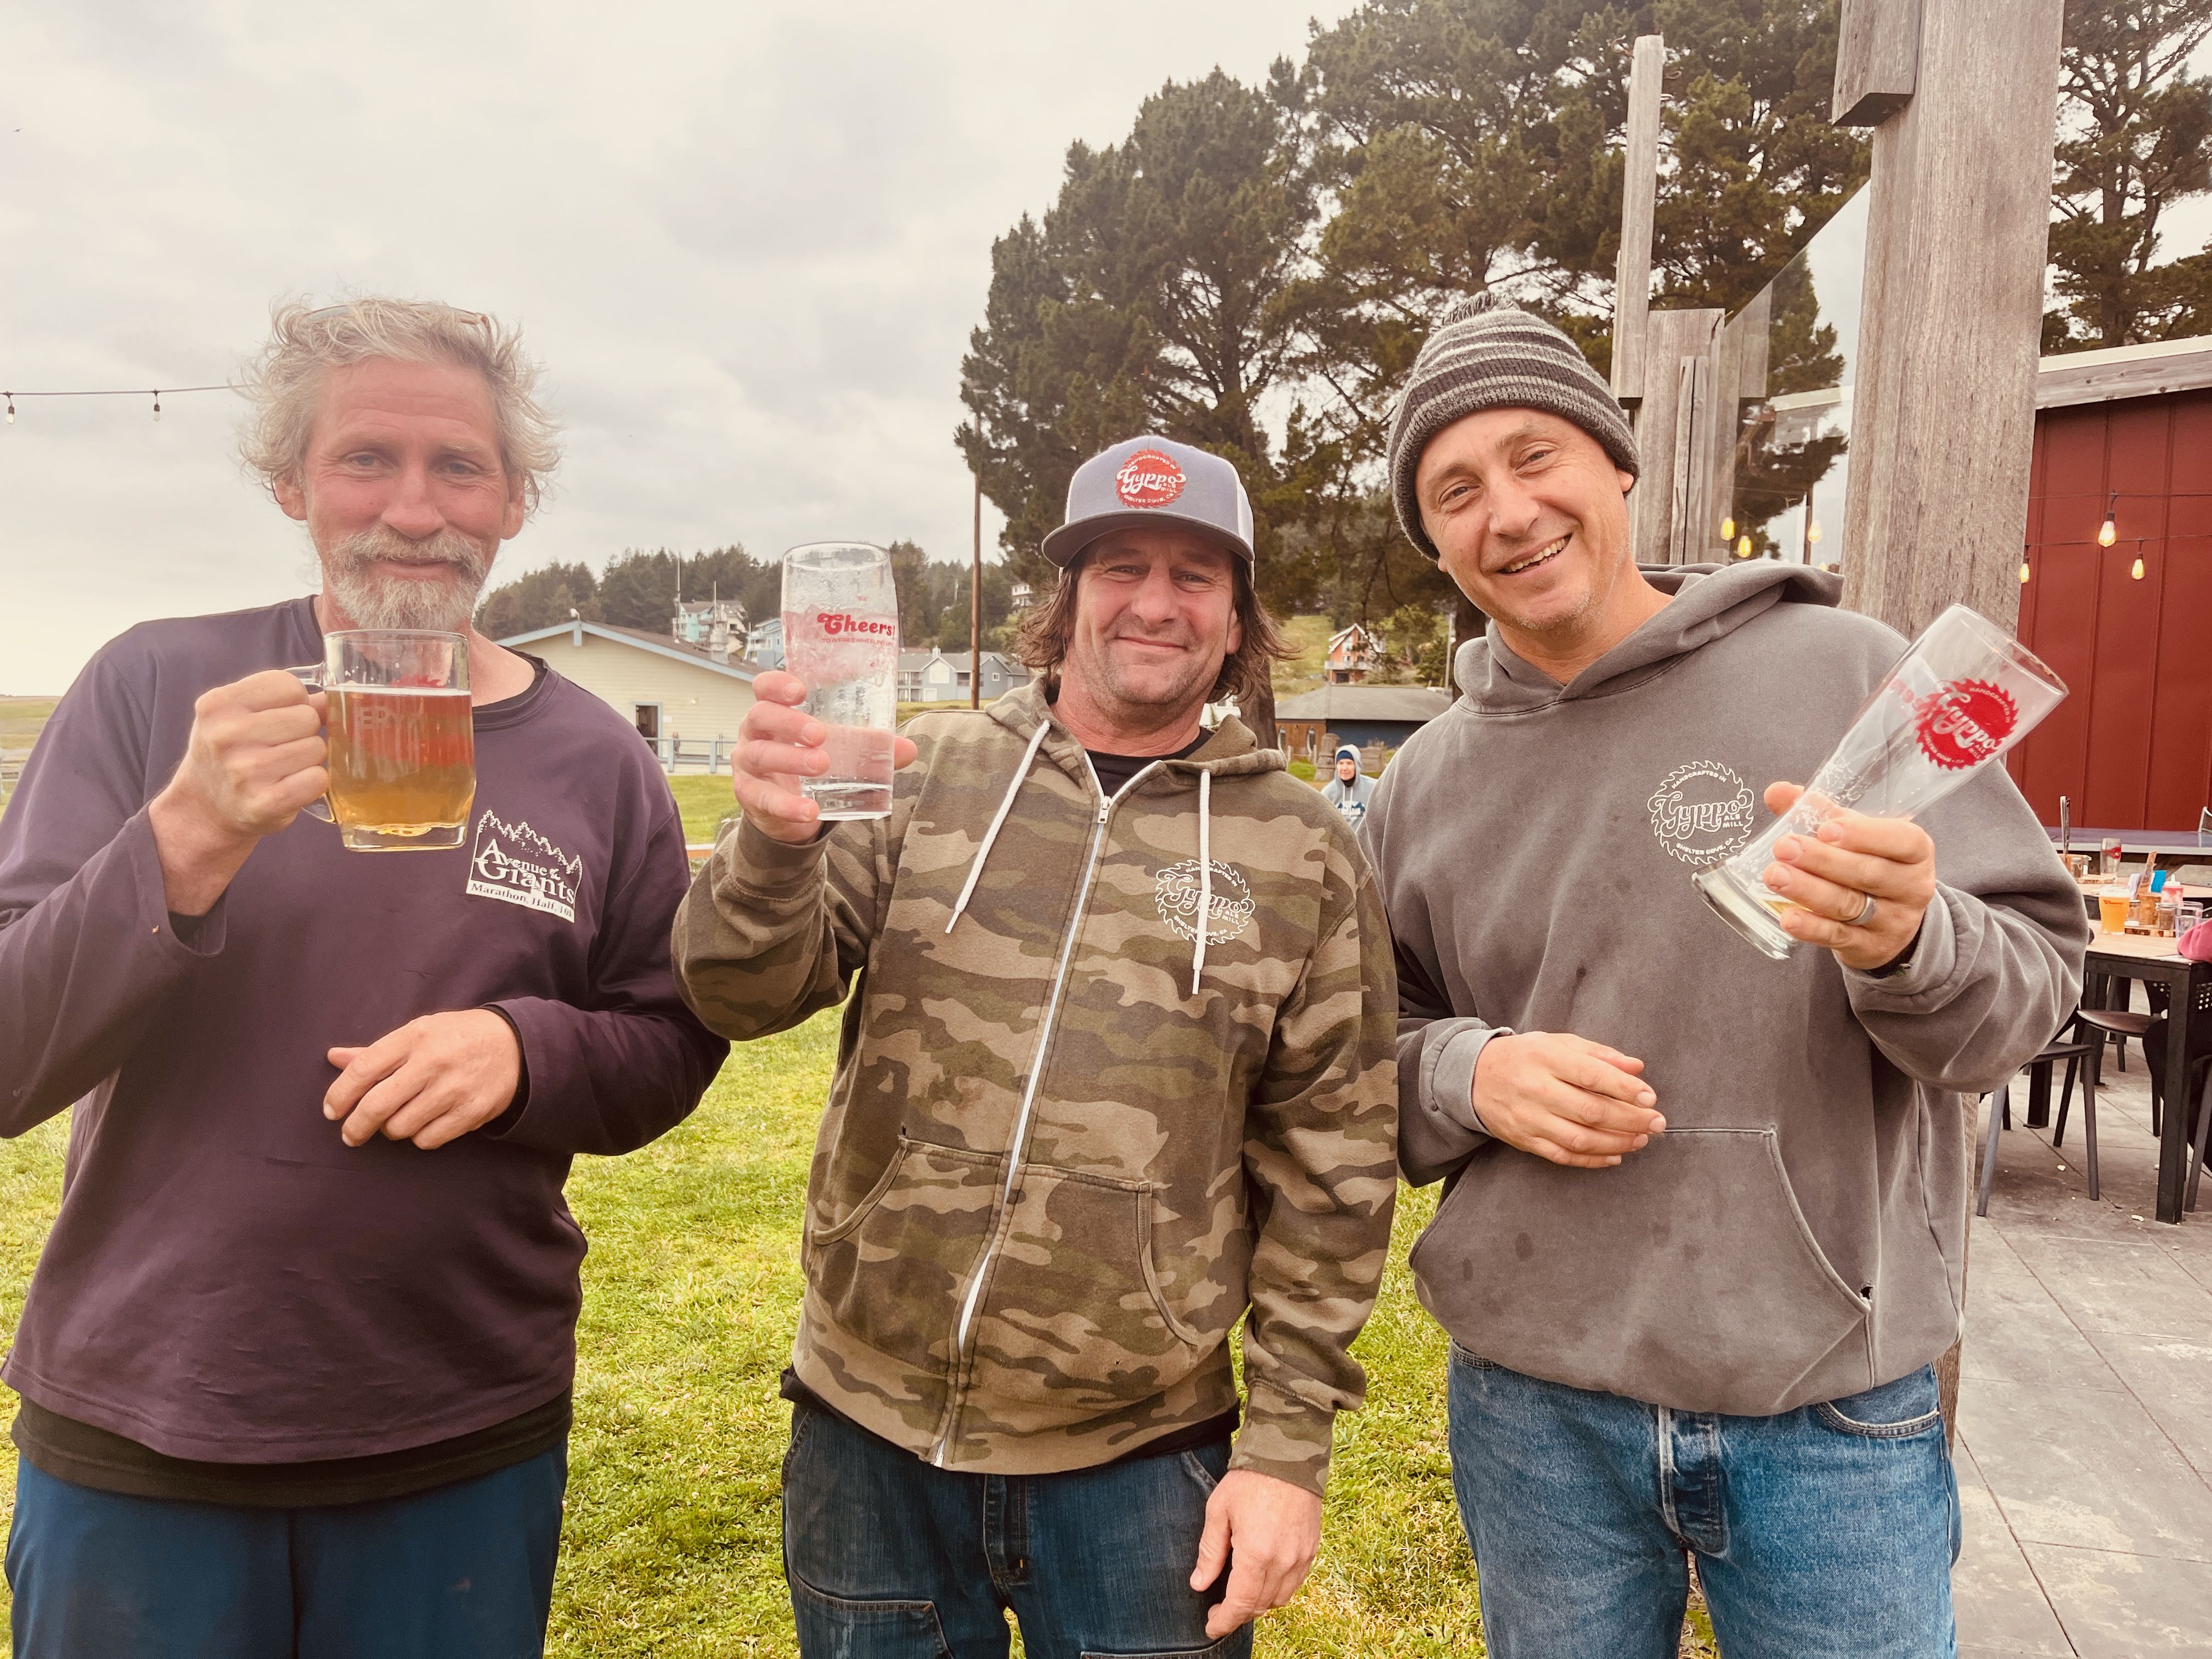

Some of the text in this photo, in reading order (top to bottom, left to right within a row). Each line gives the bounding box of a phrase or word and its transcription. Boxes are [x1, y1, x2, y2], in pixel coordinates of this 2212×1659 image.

[1116, 466, 1187, 494] Gyppo
[817, 613, 895, 640] Cheers!
[1672, 770, 1719, 789] HANDCRAFTED
[1647, 788, 1754, 840] Gyppo
[475, 839, 548, 876] Avenue
[1676, 843, 1705, 855] SHELTER
[475, 850, 575, 904] Giants
[1186, 866, 1232, 881] HANRAFTED
[471, 883, 529, 904] Marathon,
[532, 897, 556, 911] Half,
[1222, 915, 1240, 926] MILL
[1225, 910, 1239, 918] ALE
